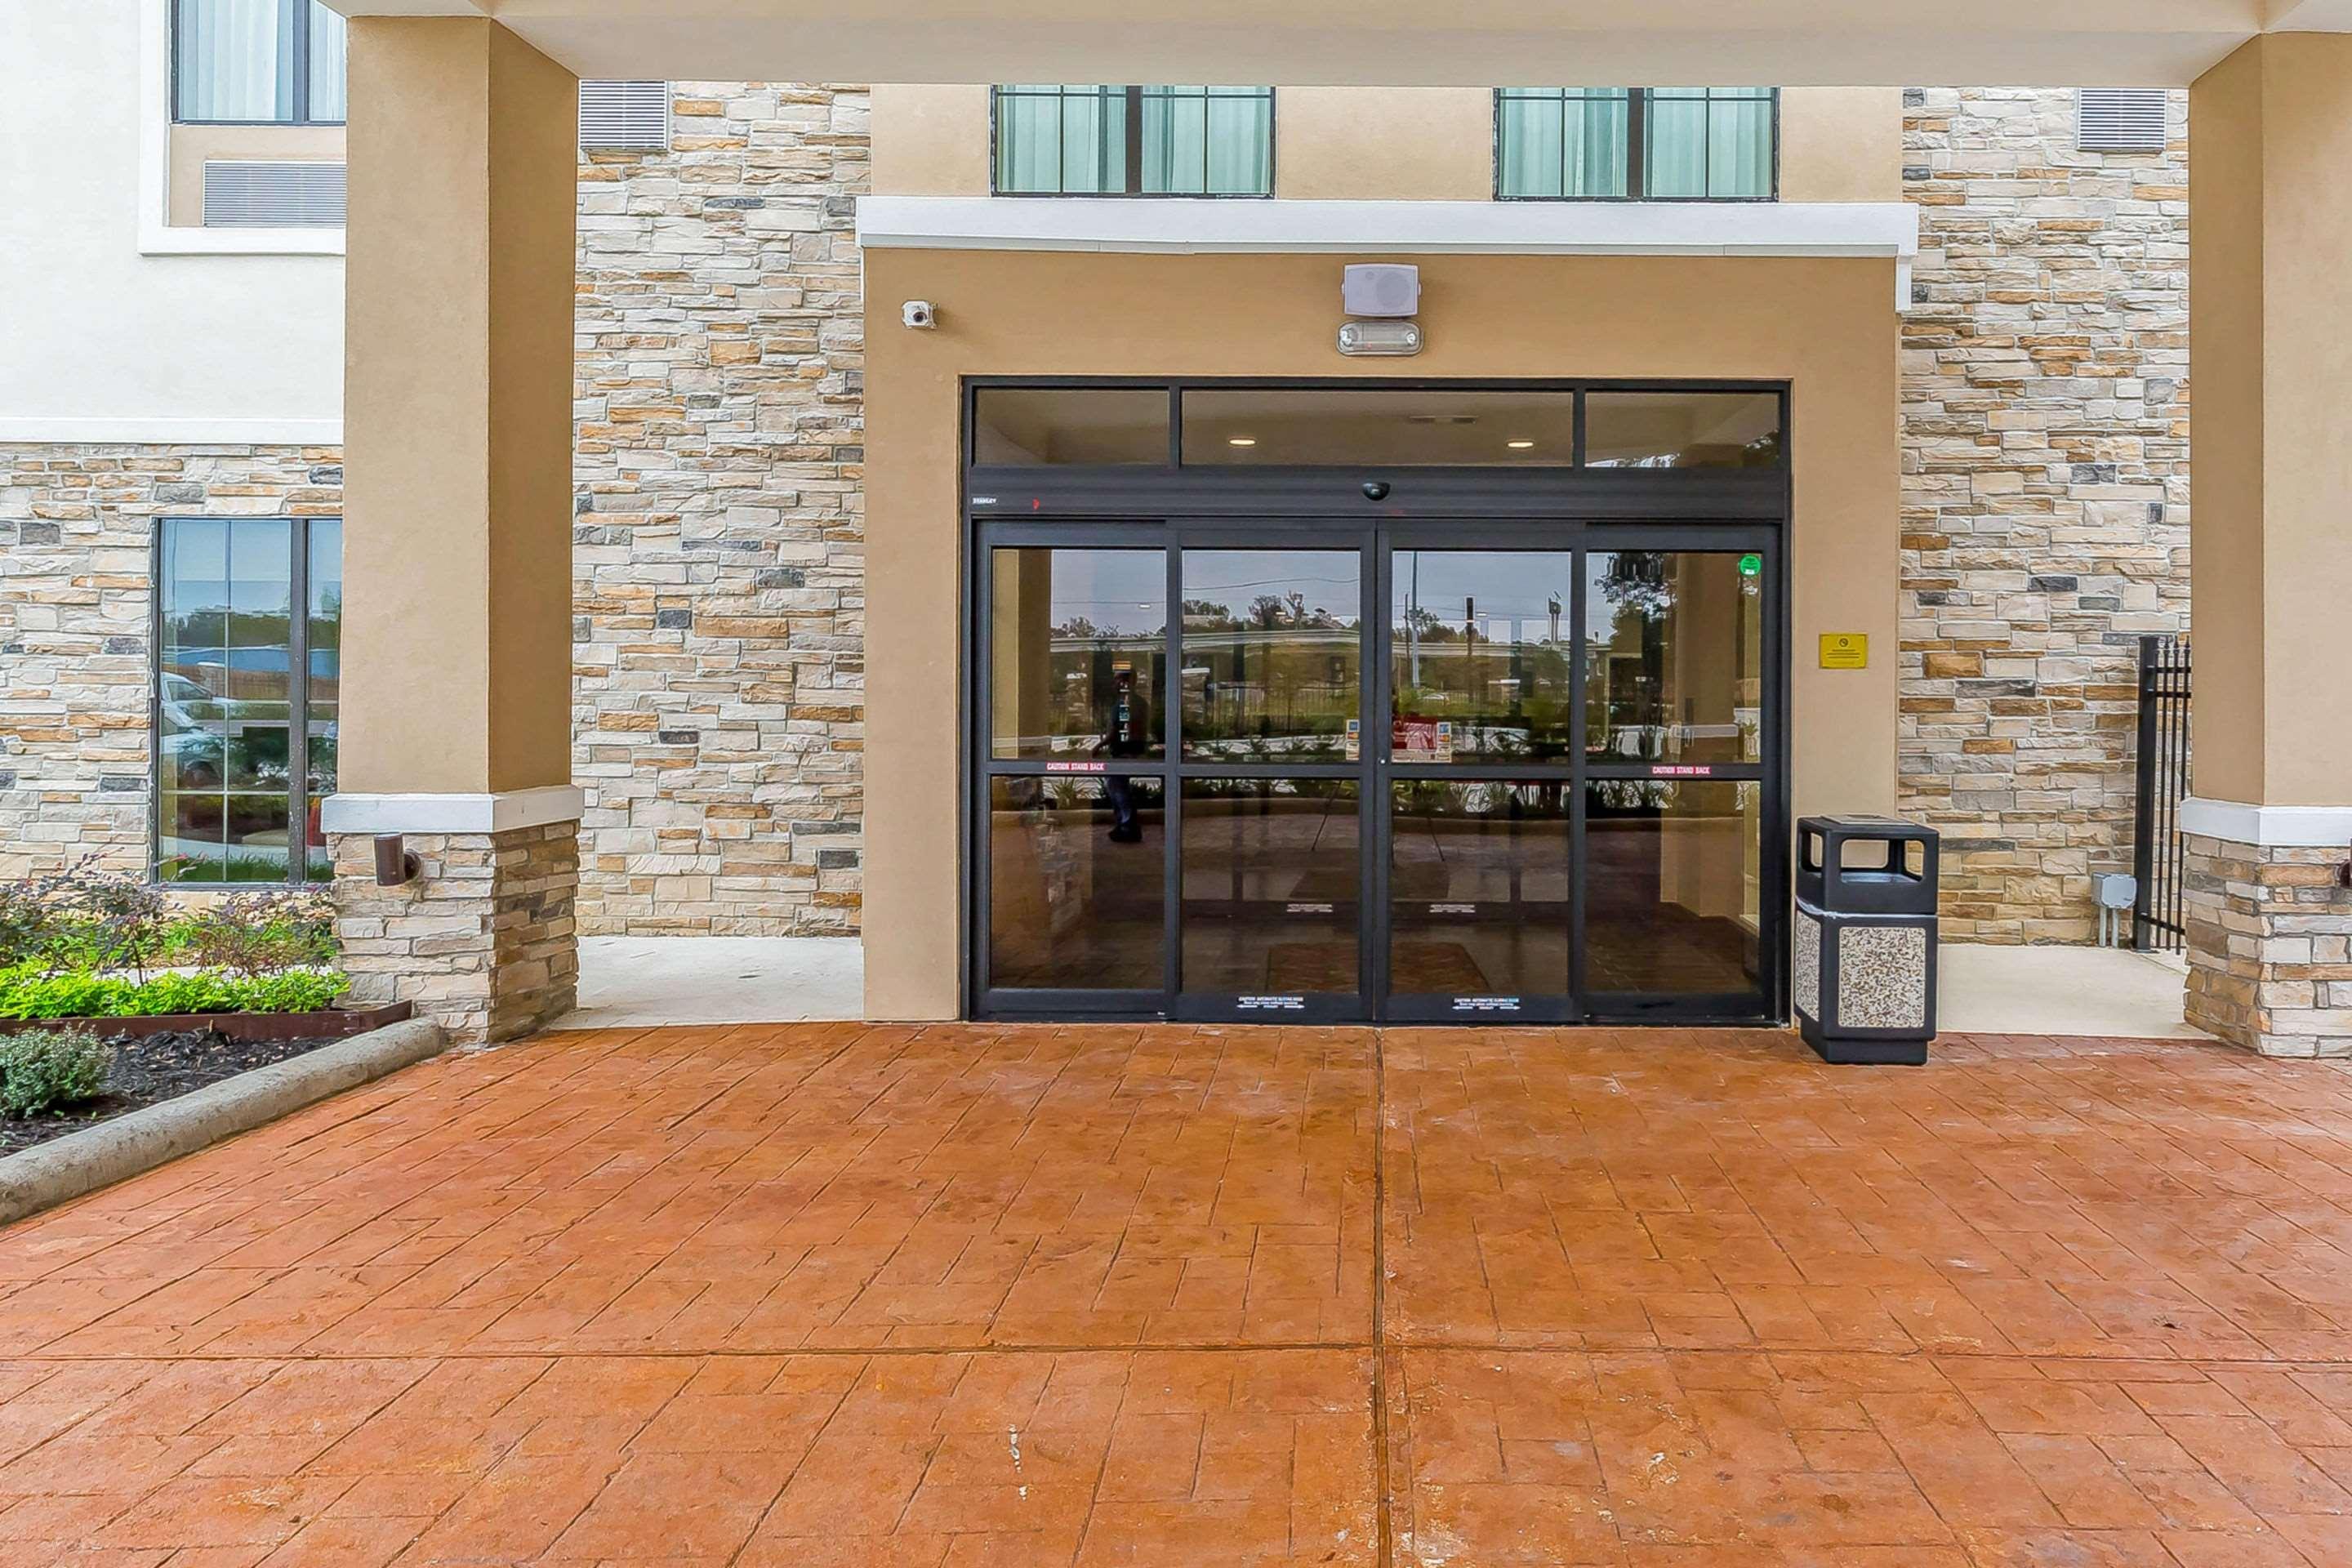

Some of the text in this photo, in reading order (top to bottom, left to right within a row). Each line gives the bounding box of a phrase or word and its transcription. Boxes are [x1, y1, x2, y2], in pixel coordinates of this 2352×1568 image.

[1047, 762, 1105, 771] CAUTION STAND BACK
[1652, 766, 1711, 774] CAUTION STAND BACK
